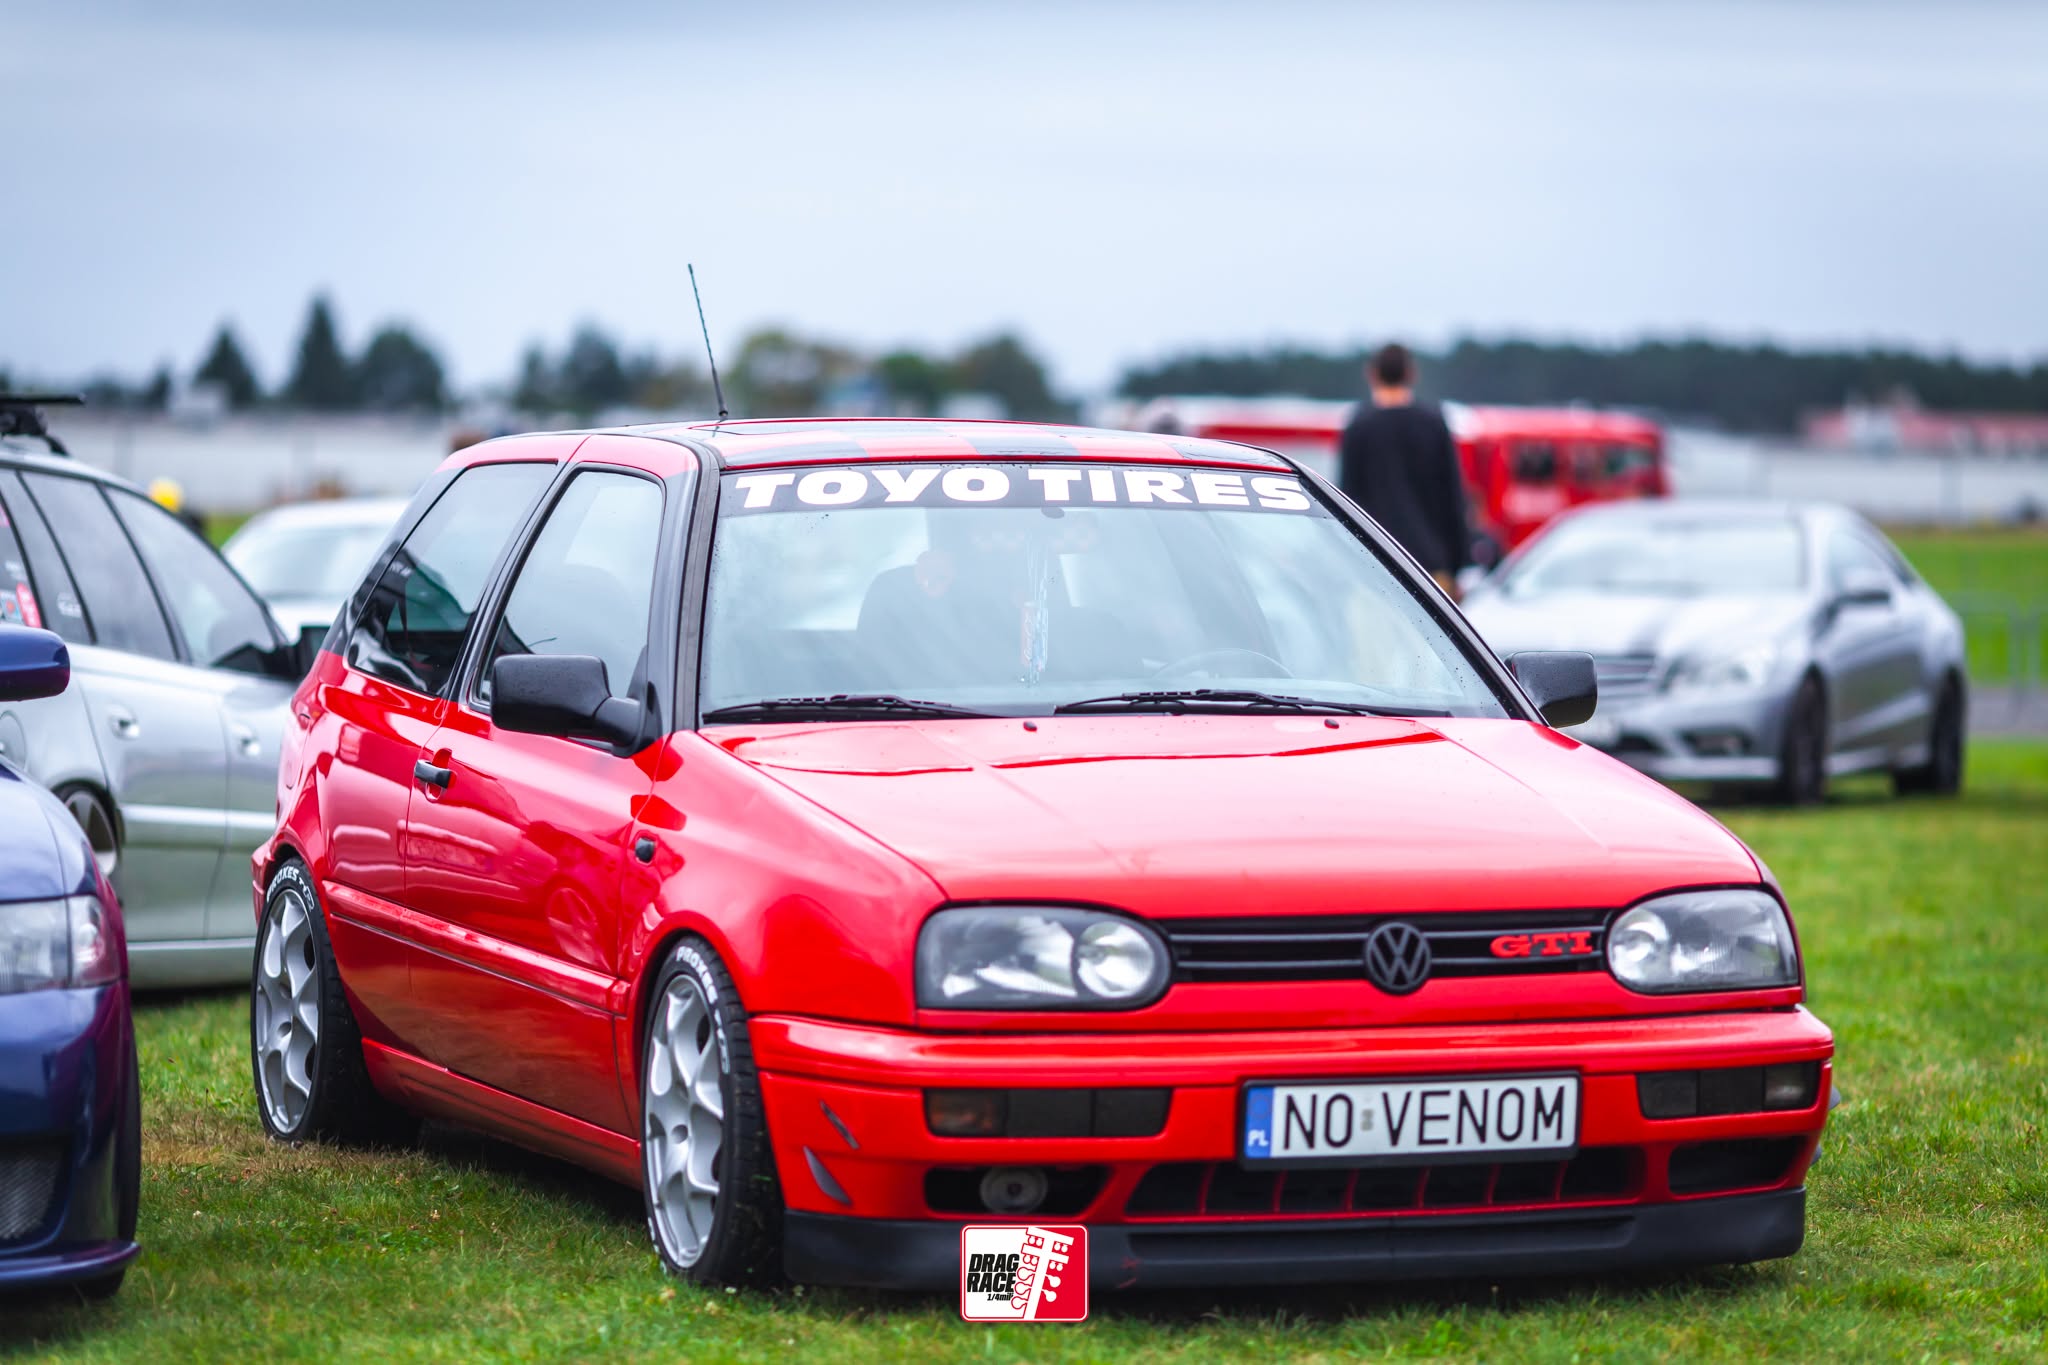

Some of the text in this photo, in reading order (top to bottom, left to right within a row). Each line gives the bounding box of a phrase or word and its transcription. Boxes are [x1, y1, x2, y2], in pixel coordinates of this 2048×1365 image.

[735, 467, 1310, 510] TOYO TIRES
[1490, 931, 1593, 957] GTI
[1283, 1085, 1565, 1150] NO VENOM
[1248, 1129, 1269, 1148] PL
